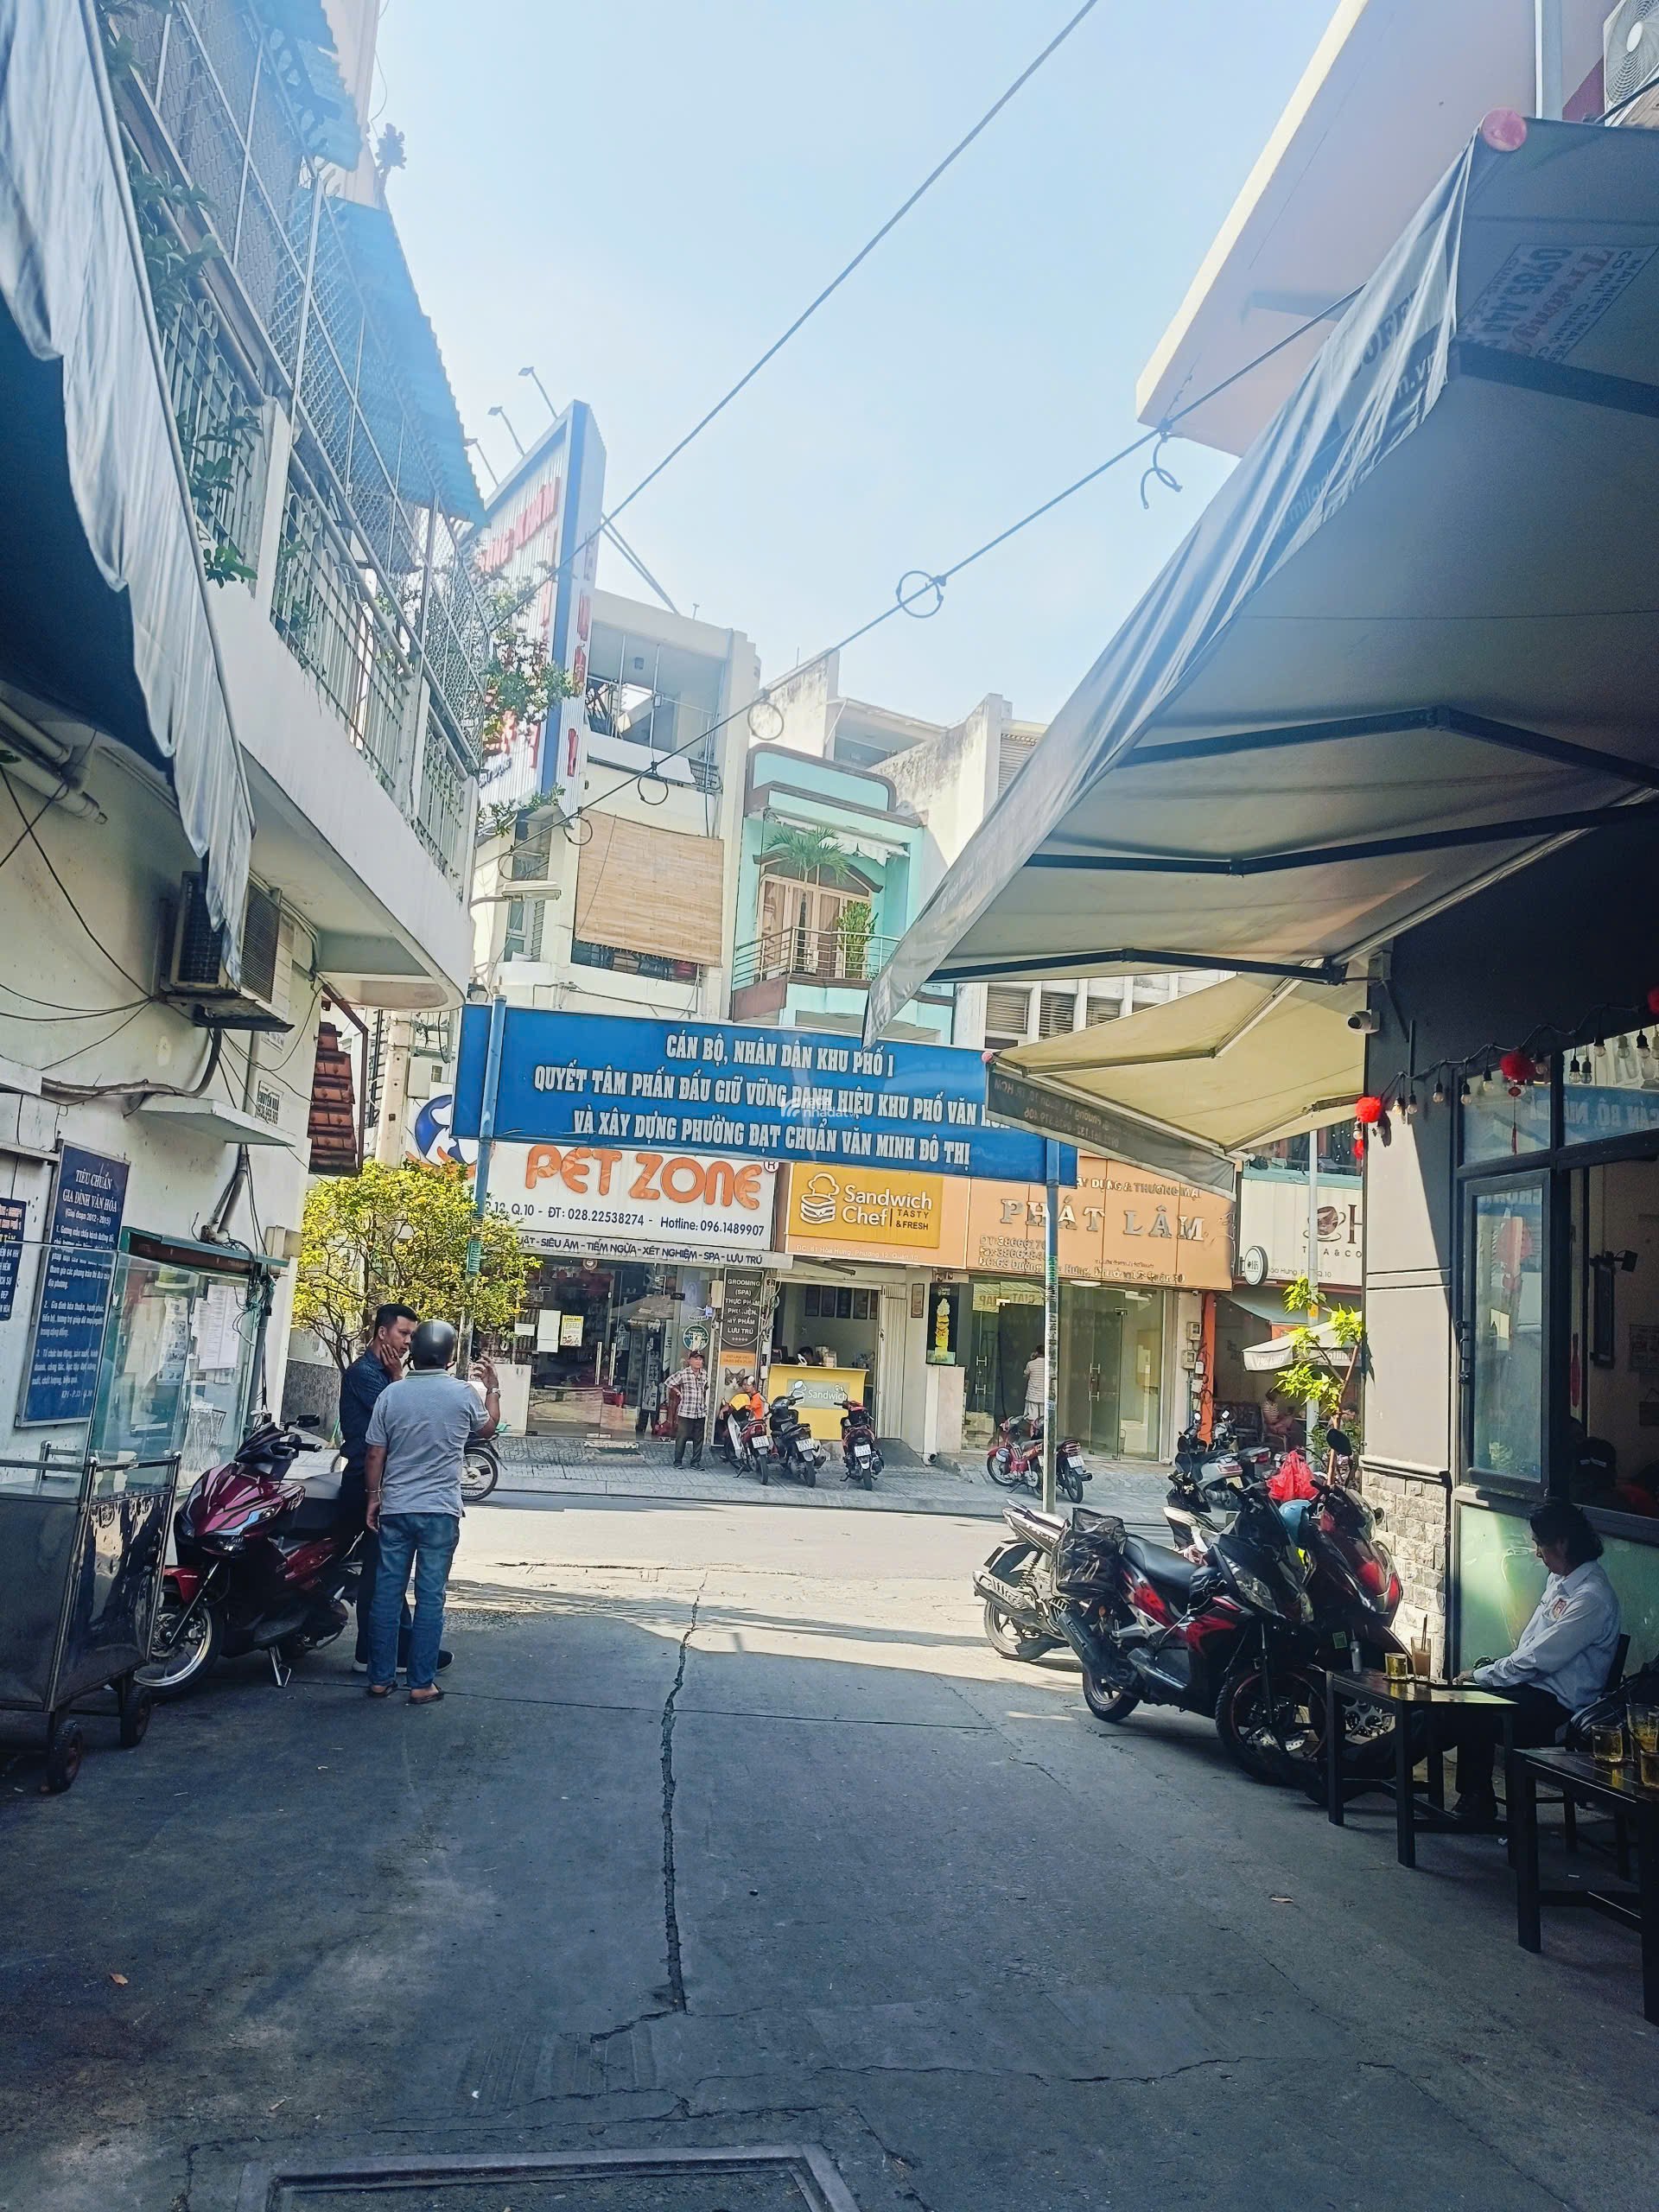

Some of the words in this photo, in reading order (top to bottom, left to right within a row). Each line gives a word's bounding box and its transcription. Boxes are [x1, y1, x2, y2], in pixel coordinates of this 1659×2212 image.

[666, 1030, 698, 1059] CÁN
[702, 1033, 728, 1066] BỘ,
[733, 1037, 777, 1066] NHÂN
[780, 1039, 812, 1069] DÂN
[817, 1047, 849, 1072] KHU
[853, 1046, 884, 1076] PHỐ
[534, 1059, 588, 1091] QUYẾT
[592, 1065, 627, 1095] TÂM
[631, 1066, 675, 1098] PHẤN
[678, 1069, 711, 1102] ĐẤU
[715, 1076, 743, 1104] GIỮ
[747, 1077, 786, 1107] VỮNG
[791, 1086, 834, 1110] DANH
[838, 1086, 874, 1120] HIỆU
[877, 1094, 909, 1119] KHU
[912, 1091, 944, 1122] PHỐ
[947, 1097, 977, 1126] VĂN
[574, 1104, 594, 1134] VÀ
[598, 1107, 631, 1136] XÂY
[633, 1110, 677, 1144] DỰNG
[681, 1115, 744, 1146] PHƯỜNG
[748, 1123, 781, 1154] ĐẠT
[785, 1118, 837, 1153] CHUẨN
[842, 1127, 872, 1155] VĂN
[875, 1134, 916, 1160] MINH
[918, 1134, 939, 1162] ĐÔ
[944, 1141, 971, 1171] THỊ
[525, 1144, 622, 1196] PET
[62, 1188, 73, 1203] GIA
[843, 1183, 933, 1211] Sandwich
[511, 1203, 535, 1217] Q.10
[548, 1206, 565, 1218] ĐT:
[568, 1208, 645, 1226] 028.22538274
[660, 1217, 698, 1231] Hotline:
[700, 1220, 765, 1236] 096.1489907
[842, 1205, 887, 1227] Chef
[897, 1209, 930, 1219] TASTY
[1000, 1195, 1106, 1232] PHÁT
[1122, 1205, 1205, 1242] LÂM
[703, 1252, 721, 1262] SPA
